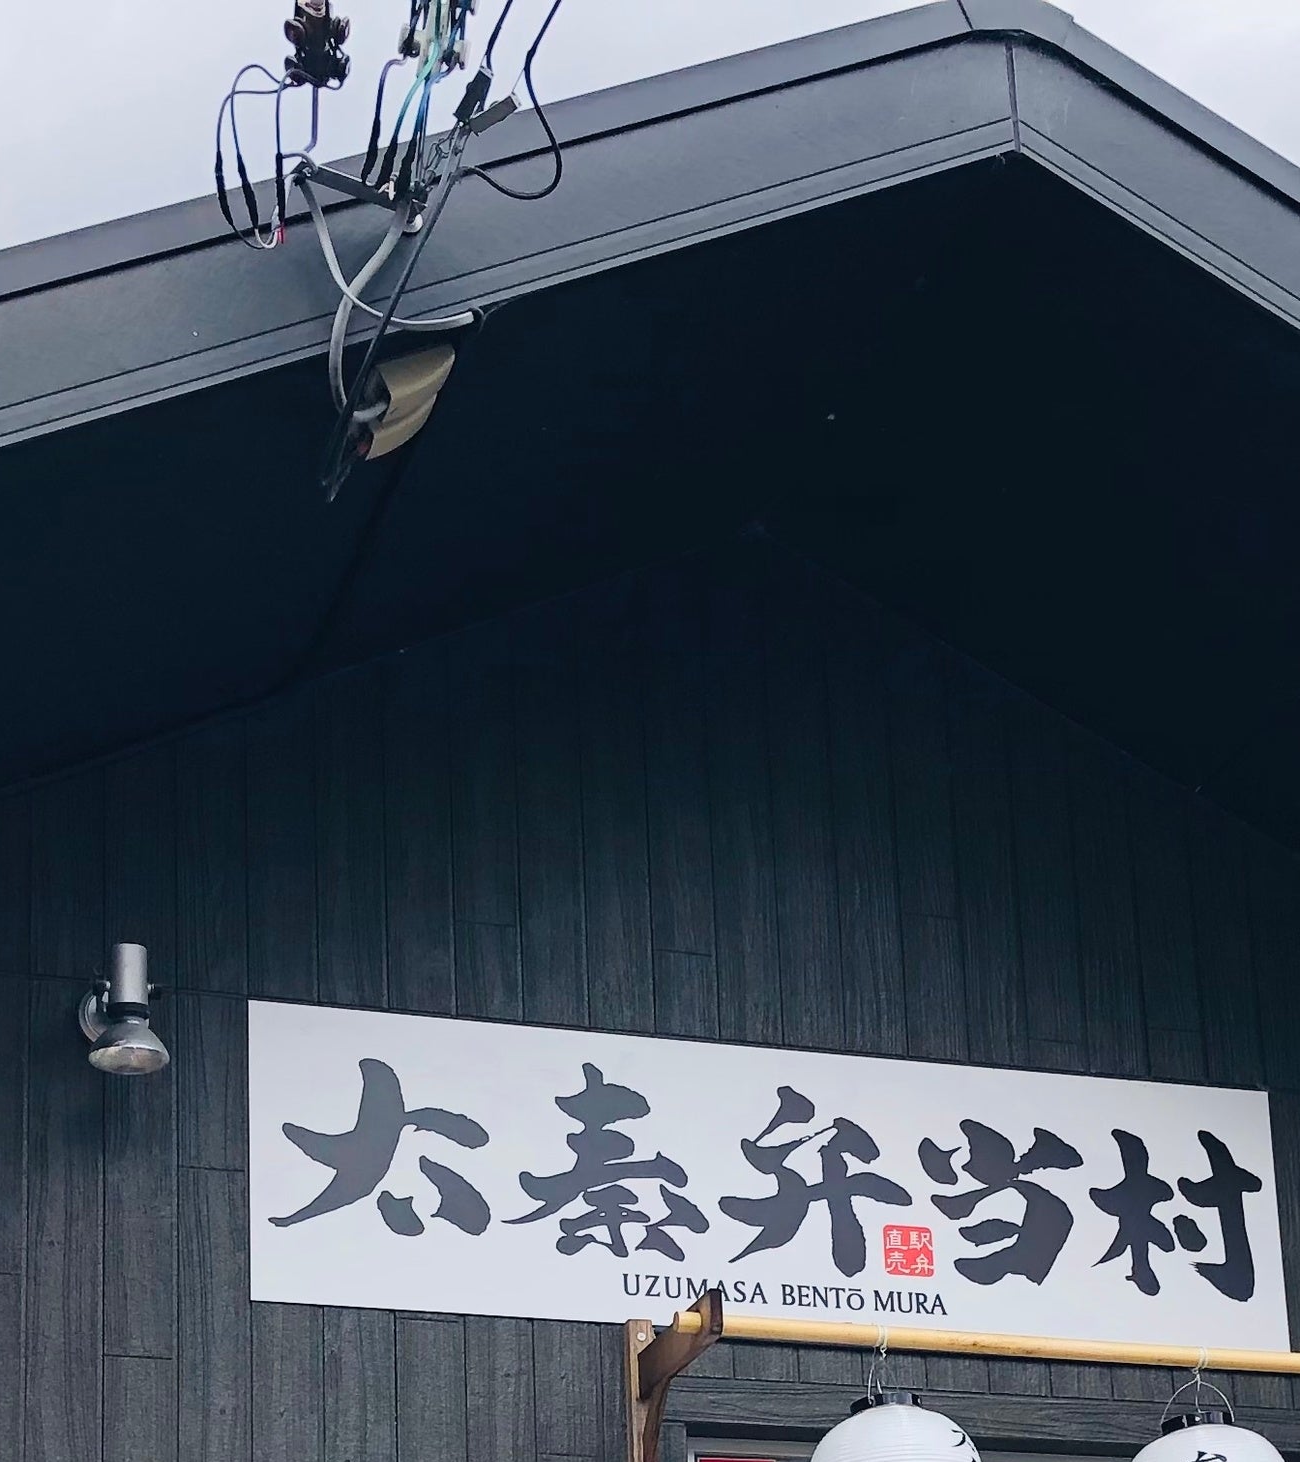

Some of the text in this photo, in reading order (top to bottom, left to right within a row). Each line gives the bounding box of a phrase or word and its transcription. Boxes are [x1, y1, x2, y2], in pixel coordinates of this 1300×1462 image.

[269, 1057, 1262, 1302] 太秦弁当村
[622, 1273, 768, 1305] UZUMASA
[874, 1289, 948, 1316] MURA
